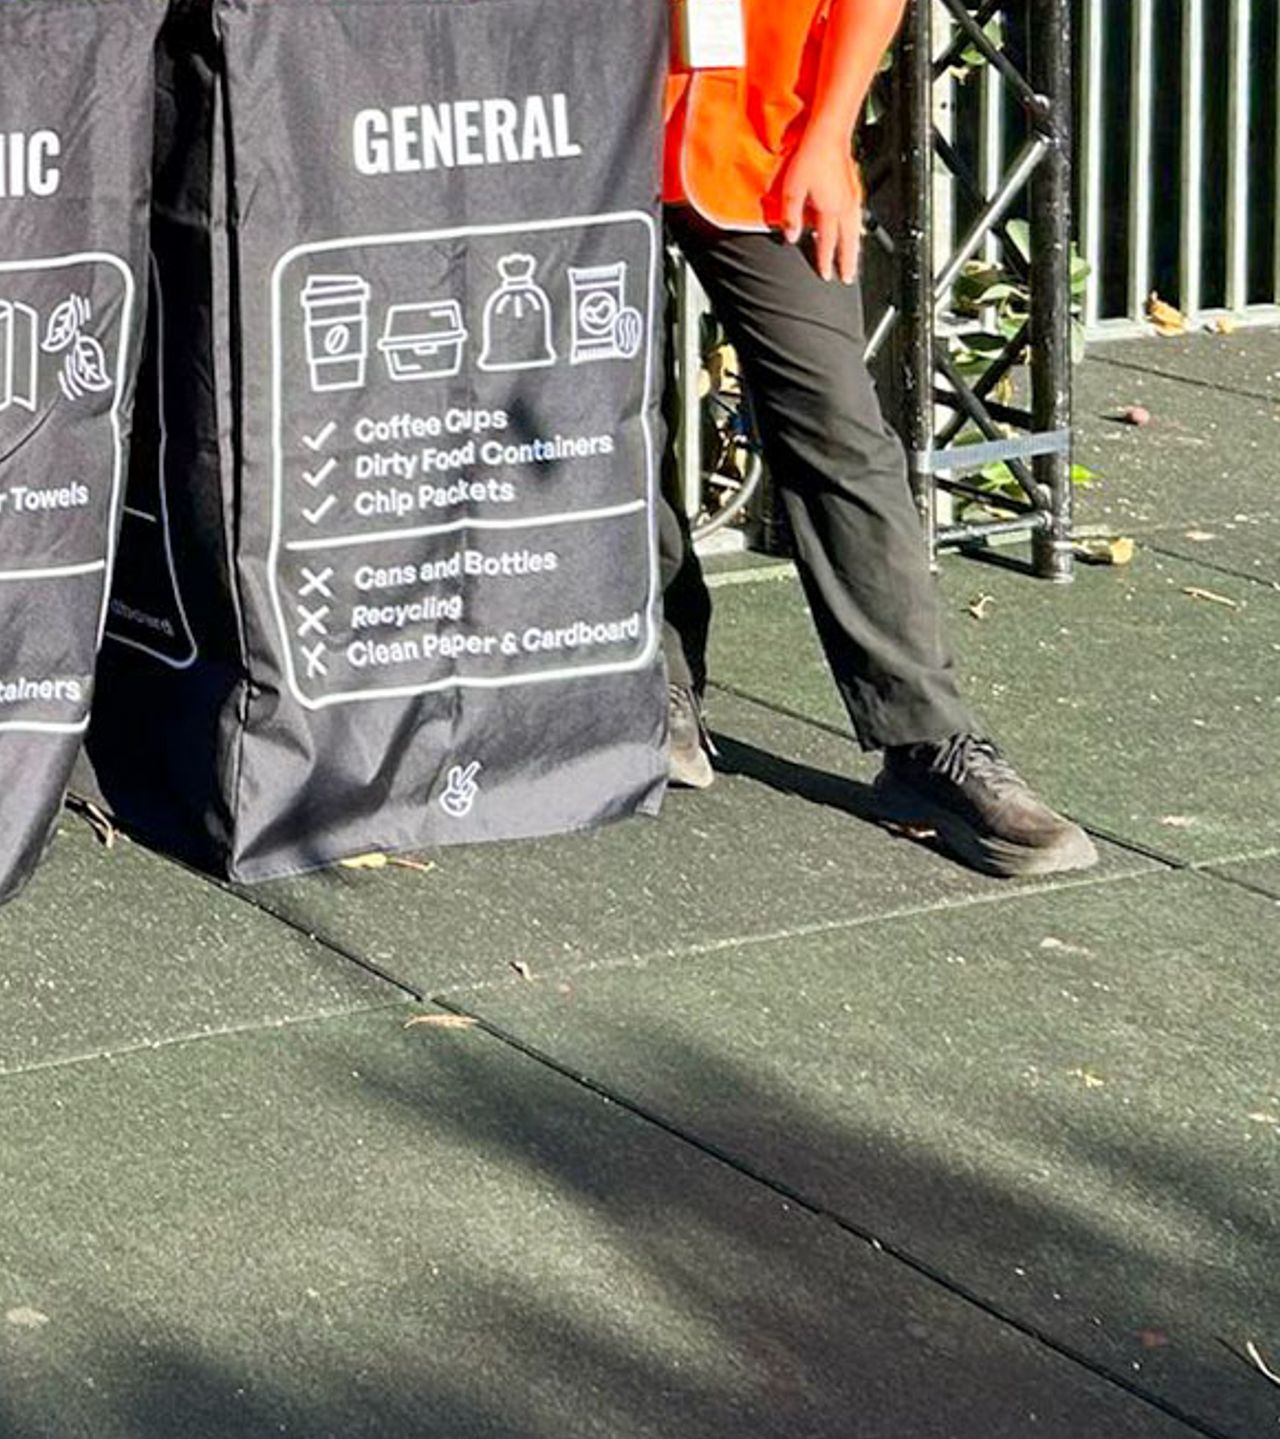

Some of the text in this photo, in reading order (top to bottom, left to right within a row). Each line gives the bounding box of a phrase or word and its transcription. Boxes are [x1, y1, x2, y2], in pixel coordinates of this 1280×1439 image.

[352, 93, 582, 175] GENERAL
[354, 408, 508, 443] Coffee Cups
[355, 434, 614, 480] Dirty Food Containers
[9, 481, 89, 511] Towels
[354, 478, 516, 517] Chip Packets
[353, 550, 558, 590] Cans and Bottles
[351, 595, 463, 629] Recycling
[346, 612, 640, 667] Clean Paper & Cardboard
